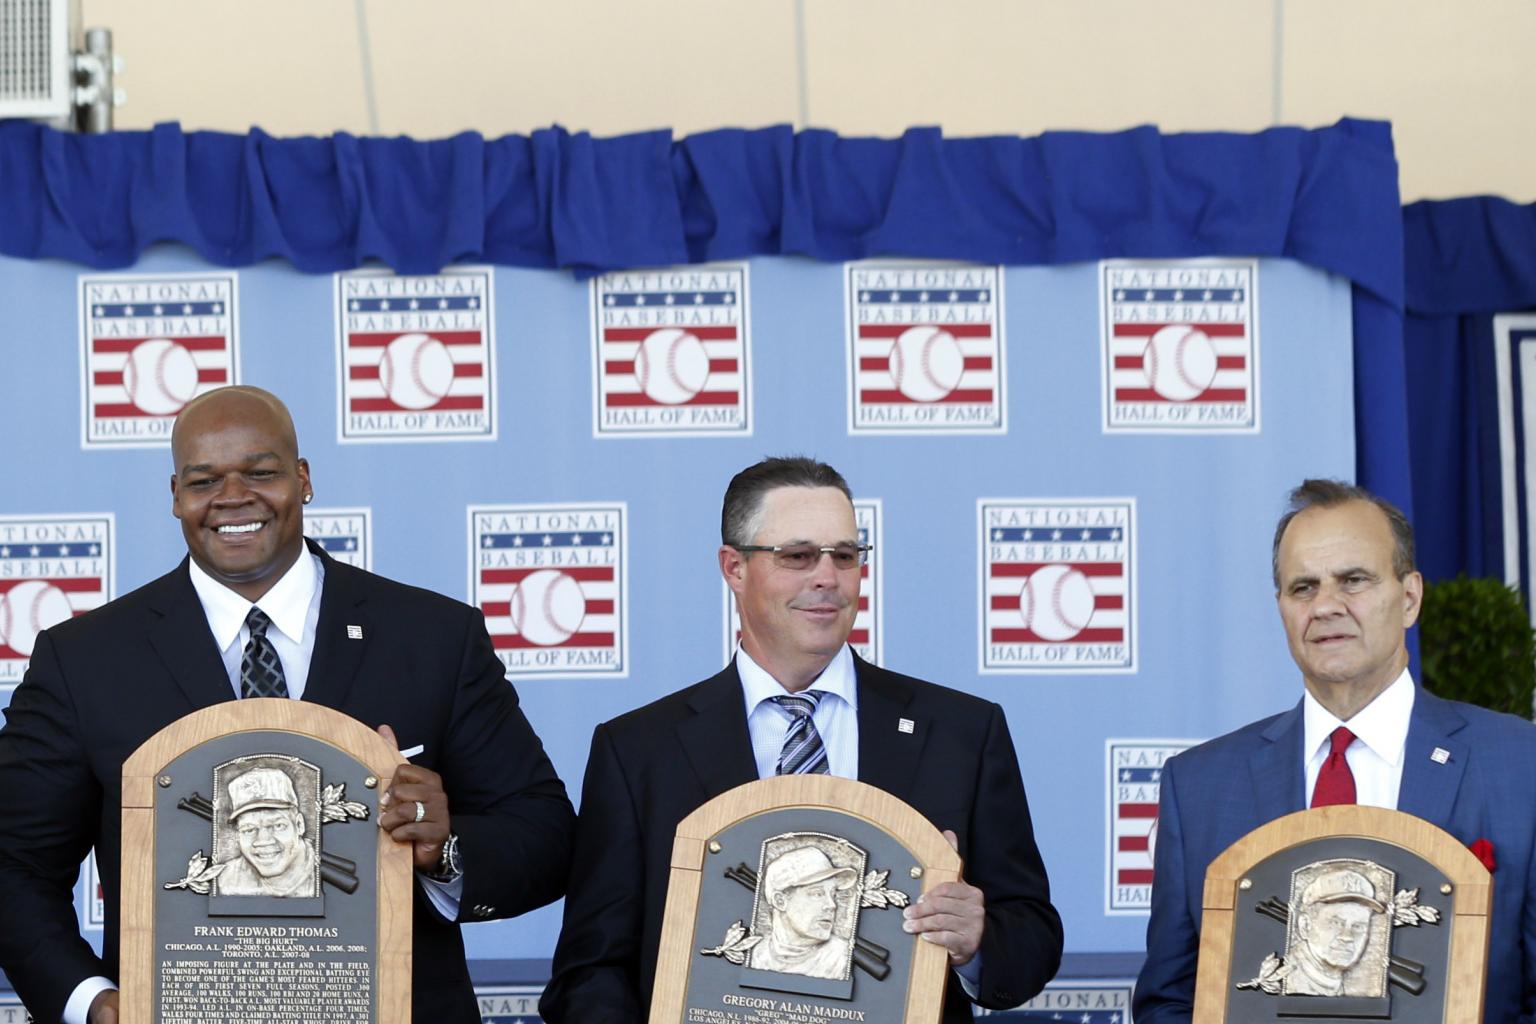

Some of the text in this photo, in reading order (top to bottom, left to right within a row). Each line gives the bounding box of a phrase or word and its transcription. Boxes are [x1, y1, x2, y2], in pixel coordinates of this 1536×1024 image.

[347, 278, 482, 296] NATIONAL
[603, 274, 737, 291] NATIONAL
[857, 271, 991, 288] NATIONAL
[1113, 271, 1245, 288] NATIONAL
[91, 285, 226, 302] NATIONAL
[349, 313, 482, 330] BASEBALL
[604, 308, 737, 325] BASEBALL
[859, 305, 991, 322] BASEBALL
[1114, 304, 1244, 322] BASEBALL
[93, 318, 226, 336] BASEBALL
[606, 406, 740, 424] HALL OF FAME
[861, 403, 995, 421] HALL OF FAME
[1115, 402, 1247, 419] HALL OF FAME
[94, 417, 172, 434] HALL OF
[350, 411, 485, 430] HALL OF FAME
[480, 512, 614, 530] NATIONAL
[990, 508, 1123, 526] NATIONAL
[481, 548, 614, 565] BASEBALL
[990, 543, 1122, 560] BASEBALL
[497, 649, 616, 668] ALL OF FAME
[990, 643, 1124, 660] HALL OF FAME
[194, 926, 338, 937] FRANK EDWARD THOMAS
[689, 1008, 724, 1017] CHICAGO,
[722, 995, 865, 1021] GREGORY ALAN MADDUX
[754, 1010, 784, 1018] "GREG"
[786, 1013, 808, 1022] "MAD
